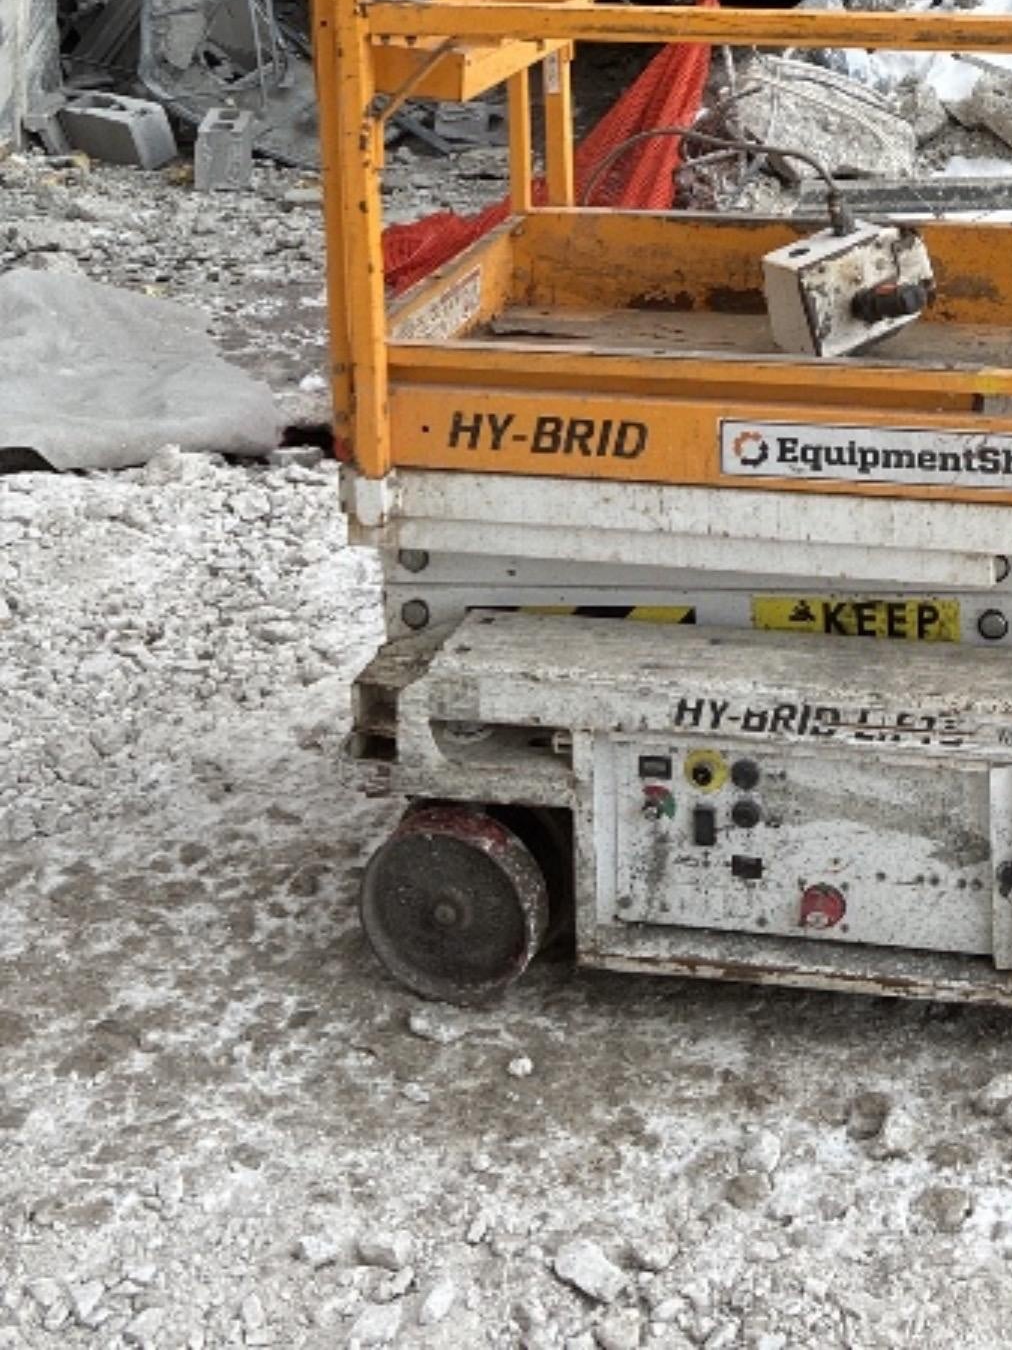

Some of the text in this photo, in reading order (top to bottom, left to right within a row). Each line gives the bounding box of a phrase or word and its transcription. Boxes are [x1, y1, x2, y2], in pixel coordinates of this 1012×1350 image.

[448, 412, 648, 460] HY-BRID
[822, 600, 940, 639] KEEP
[674, 698, 841, 736] HY-BRID
